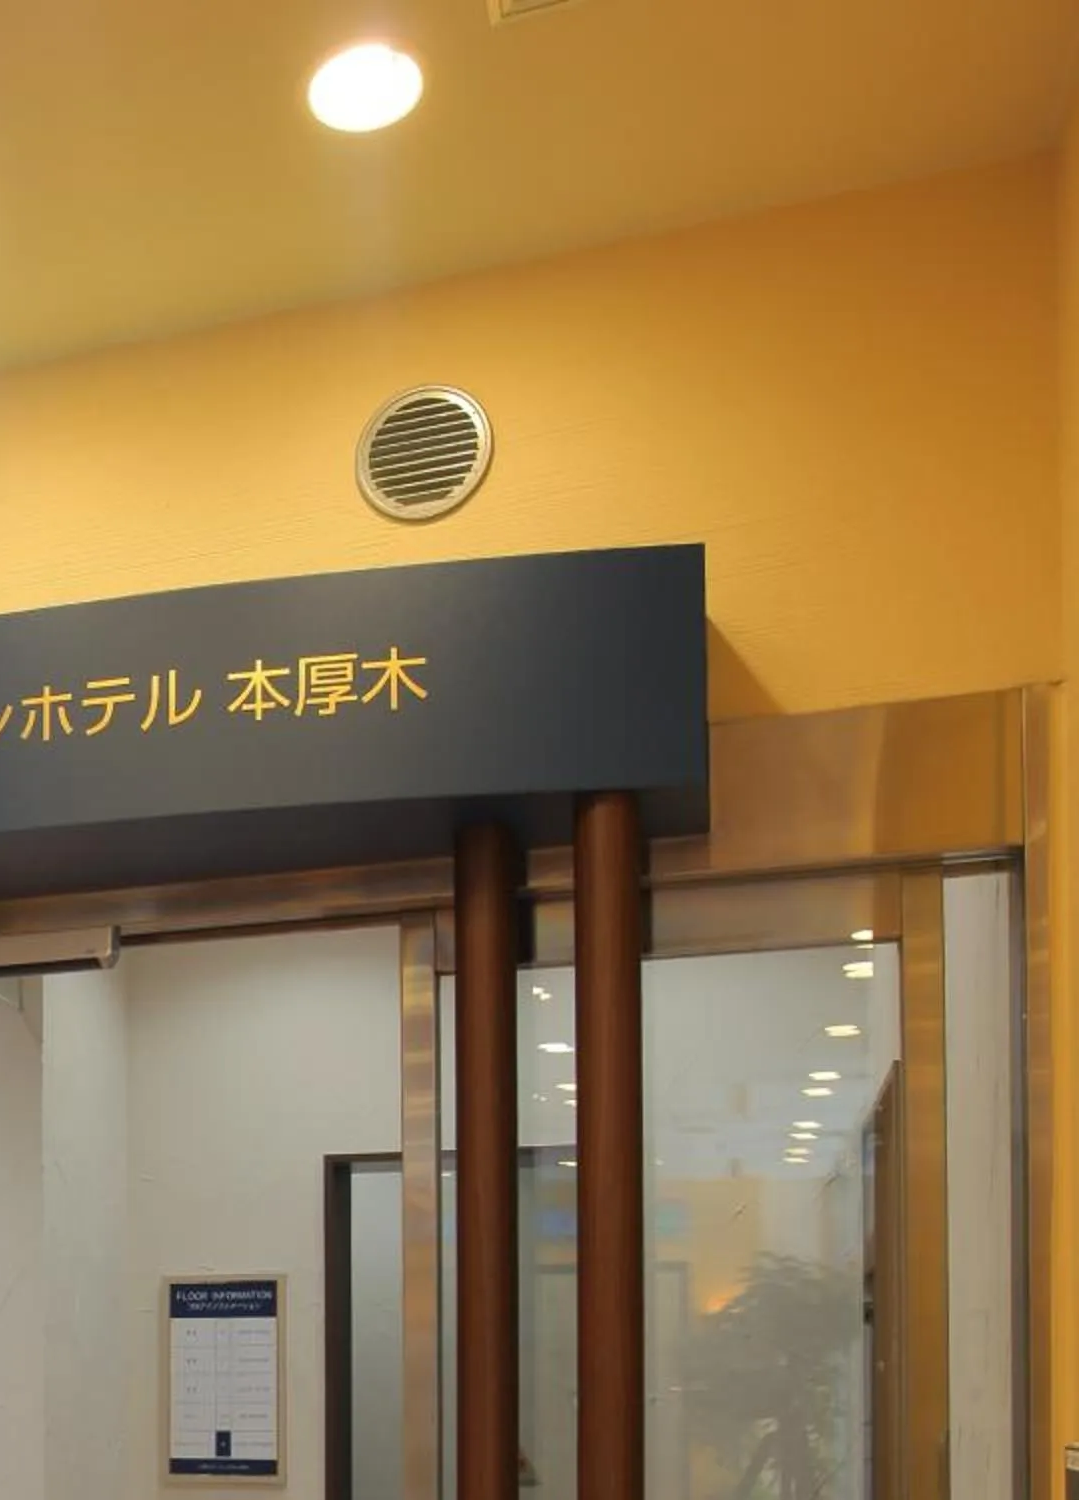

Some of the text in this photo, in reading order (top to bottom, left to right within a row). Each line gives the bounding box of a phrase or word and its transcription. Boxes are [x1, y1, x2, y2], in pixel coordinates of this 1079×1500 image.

[226, 646, 428, 721] 本厚木
[176, 1289, 273, 1302] FLOOR INFORMATION
